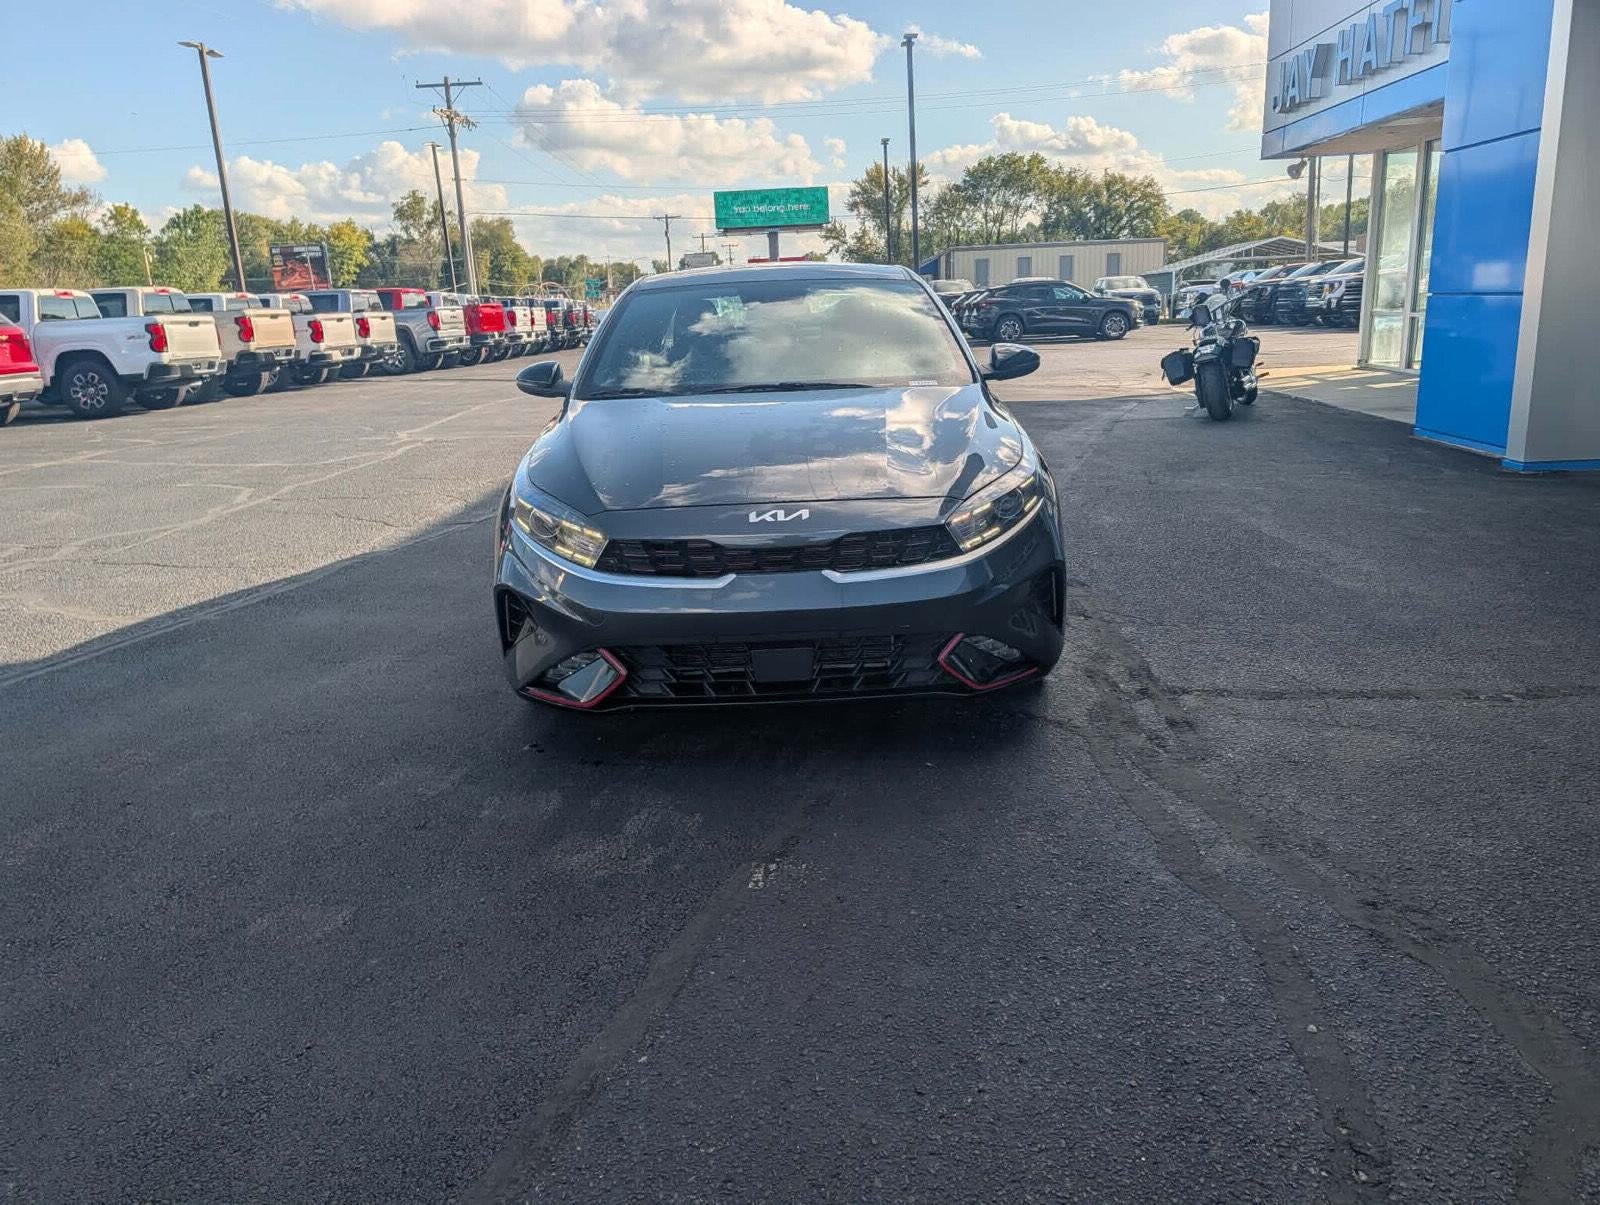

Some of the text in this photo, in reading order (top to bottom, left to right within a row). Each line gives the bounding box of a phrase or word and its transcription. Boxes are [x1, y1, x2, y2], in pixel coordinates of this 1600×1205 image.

[1273, 43, 1326, 114] JAY
[753, 203, 785, 214] belong
[748, 508, 810, 523] KIA
